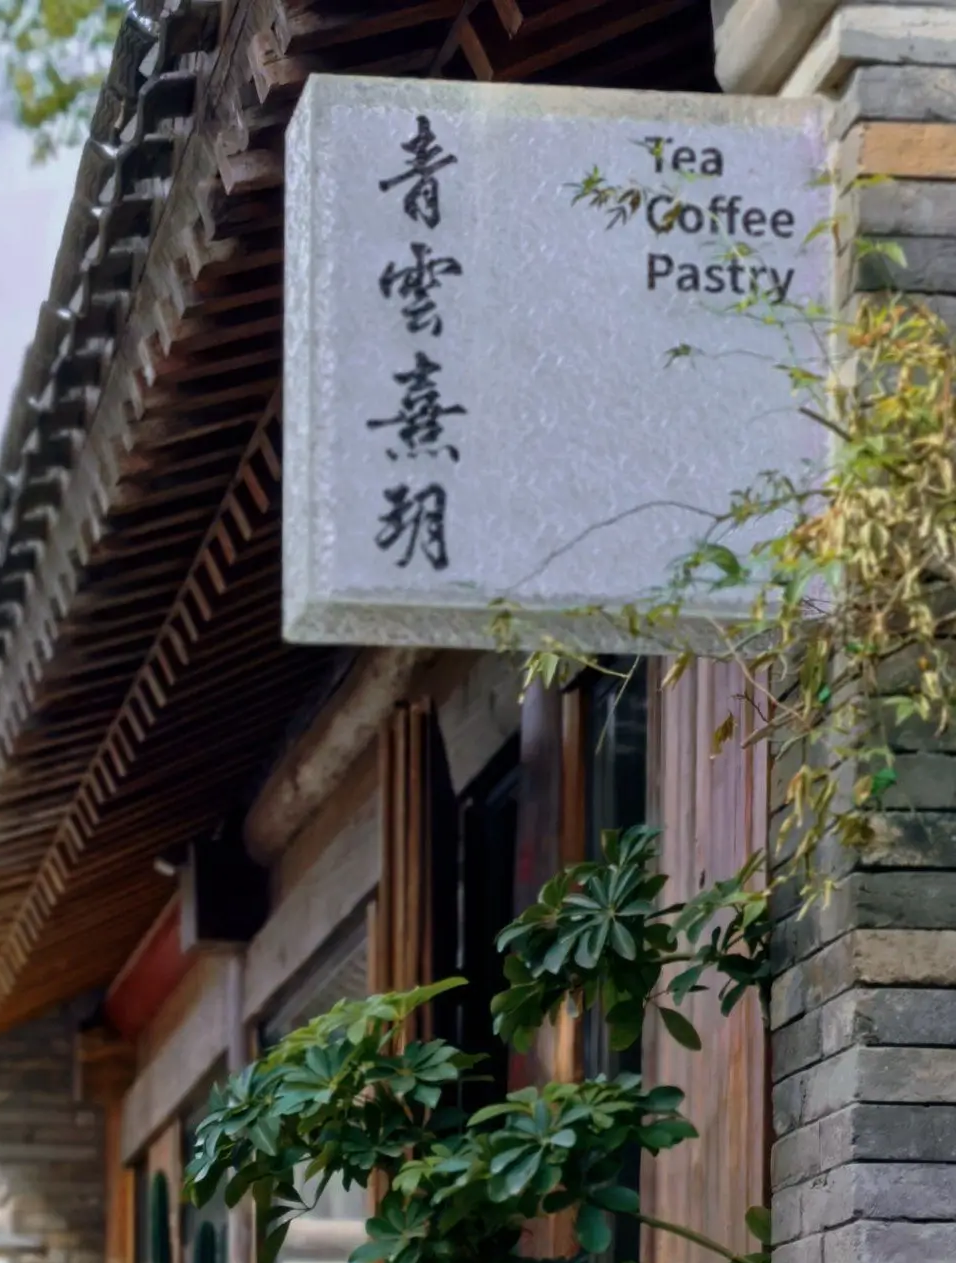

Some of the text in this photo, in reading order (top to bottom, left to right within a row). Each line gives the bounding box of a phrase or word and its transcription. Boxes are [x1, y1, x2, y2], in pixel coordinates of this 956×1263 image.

[645, 135, 725, 177] Tea
[646, 194, 795, 239] Coffee
[647, 253, 795, 304] Pastry
